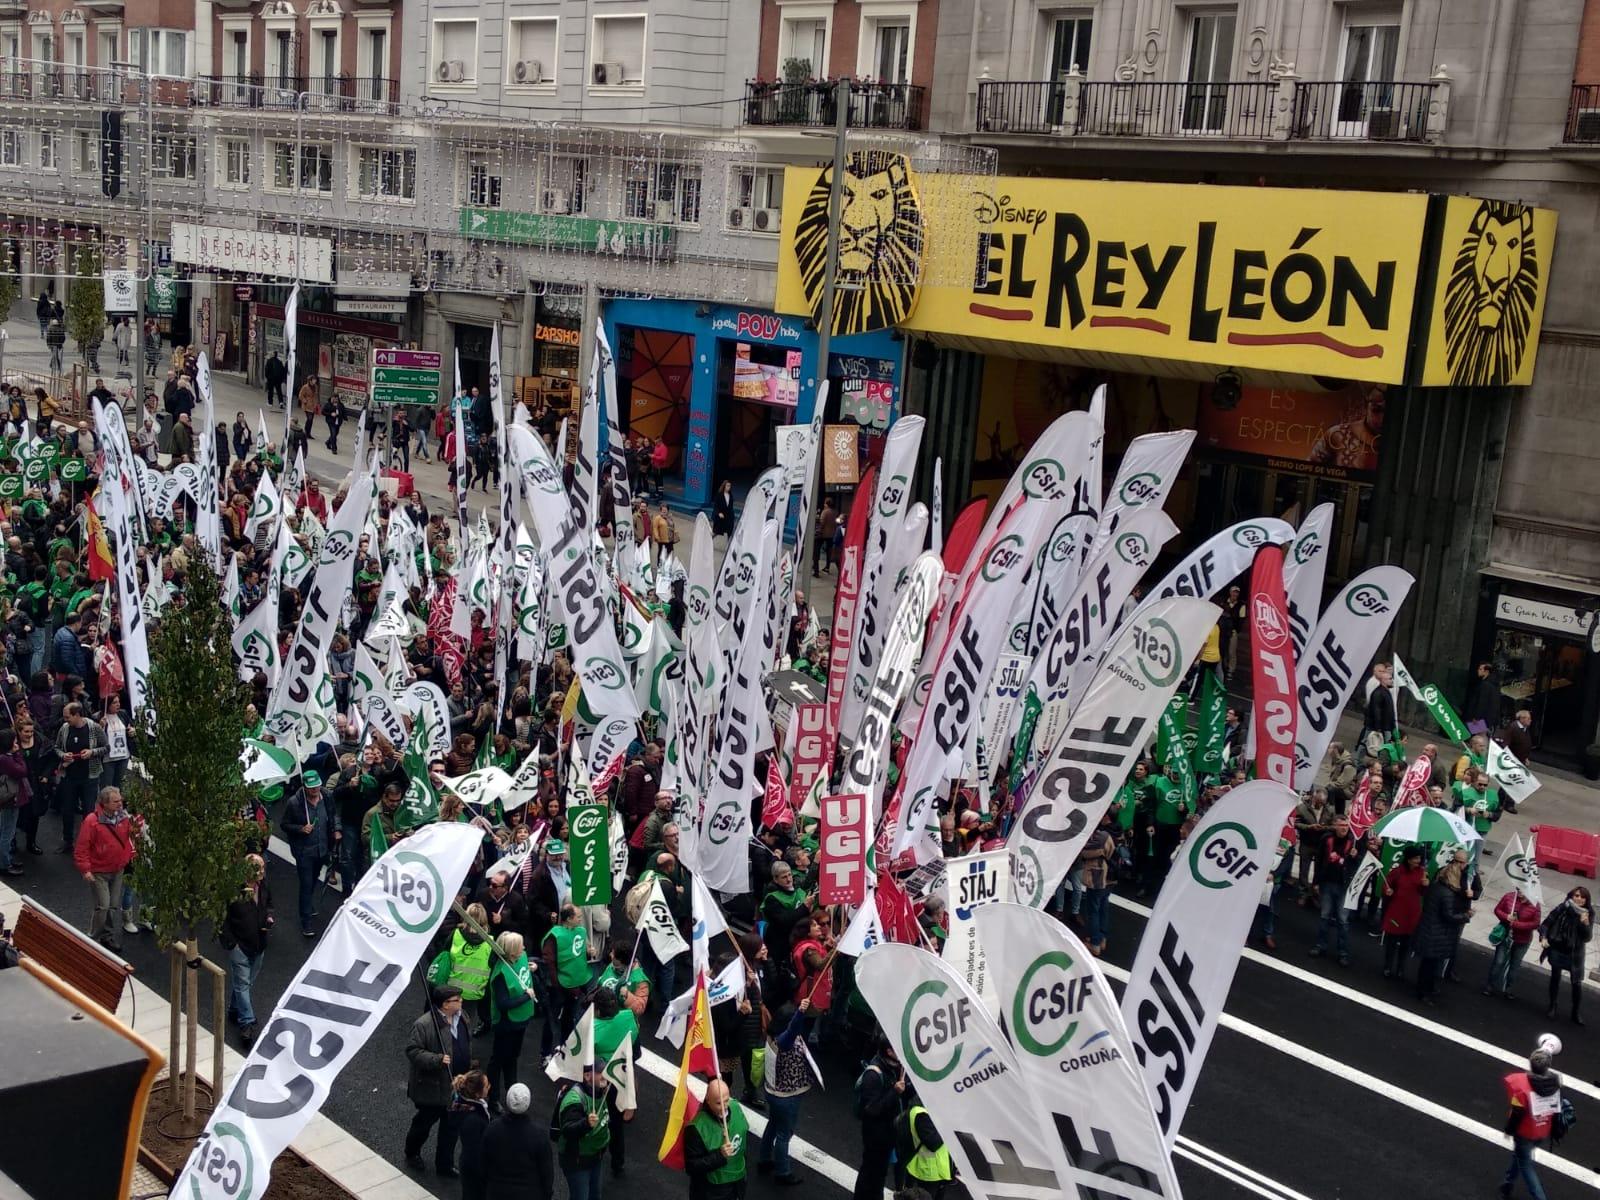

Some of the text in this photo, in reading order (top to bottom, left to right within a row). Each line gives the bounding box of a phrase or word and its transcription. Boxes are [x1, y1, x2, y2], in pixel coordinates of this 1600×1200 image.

[201, 236, 296, 265] NEBRASKA
[973, 212, 1397, 343] EL REY LEÓN
[348, 303, 395, 311] RESTAURANTE
[536, 323, 582, 345] ZAPSHO
[737, 312, 781, 340] POLY
[780, 326, 800, 340] hobby
[155, 489, 171, 516] CSIF
[991, 548, 1024, 571] CSIF
[1354, 590, 1390, 616] CSIF
[933, 614, 984, 756] CSIF
[1000, 668, 1024, 686] STAJ
[1298, 628, 1353, 733] CSIF
[796, 707, 824, 787] UGT
[578, 815, 604, 828] CSIF
[825, 798, 861, 888] UGT
[584, 839, 597, 902] CSIF
[1205, 838, 1259, 881] CSIF
[959, 870, 998, 905] STAJ
[1029, 975, 1094, 1026] CSIF
[915, 997, 972, 1054] CSIF
[1059, 1046, 1123, 1074] CORUÑA
[953, 1062, 1009, 1094] CORUÑA
